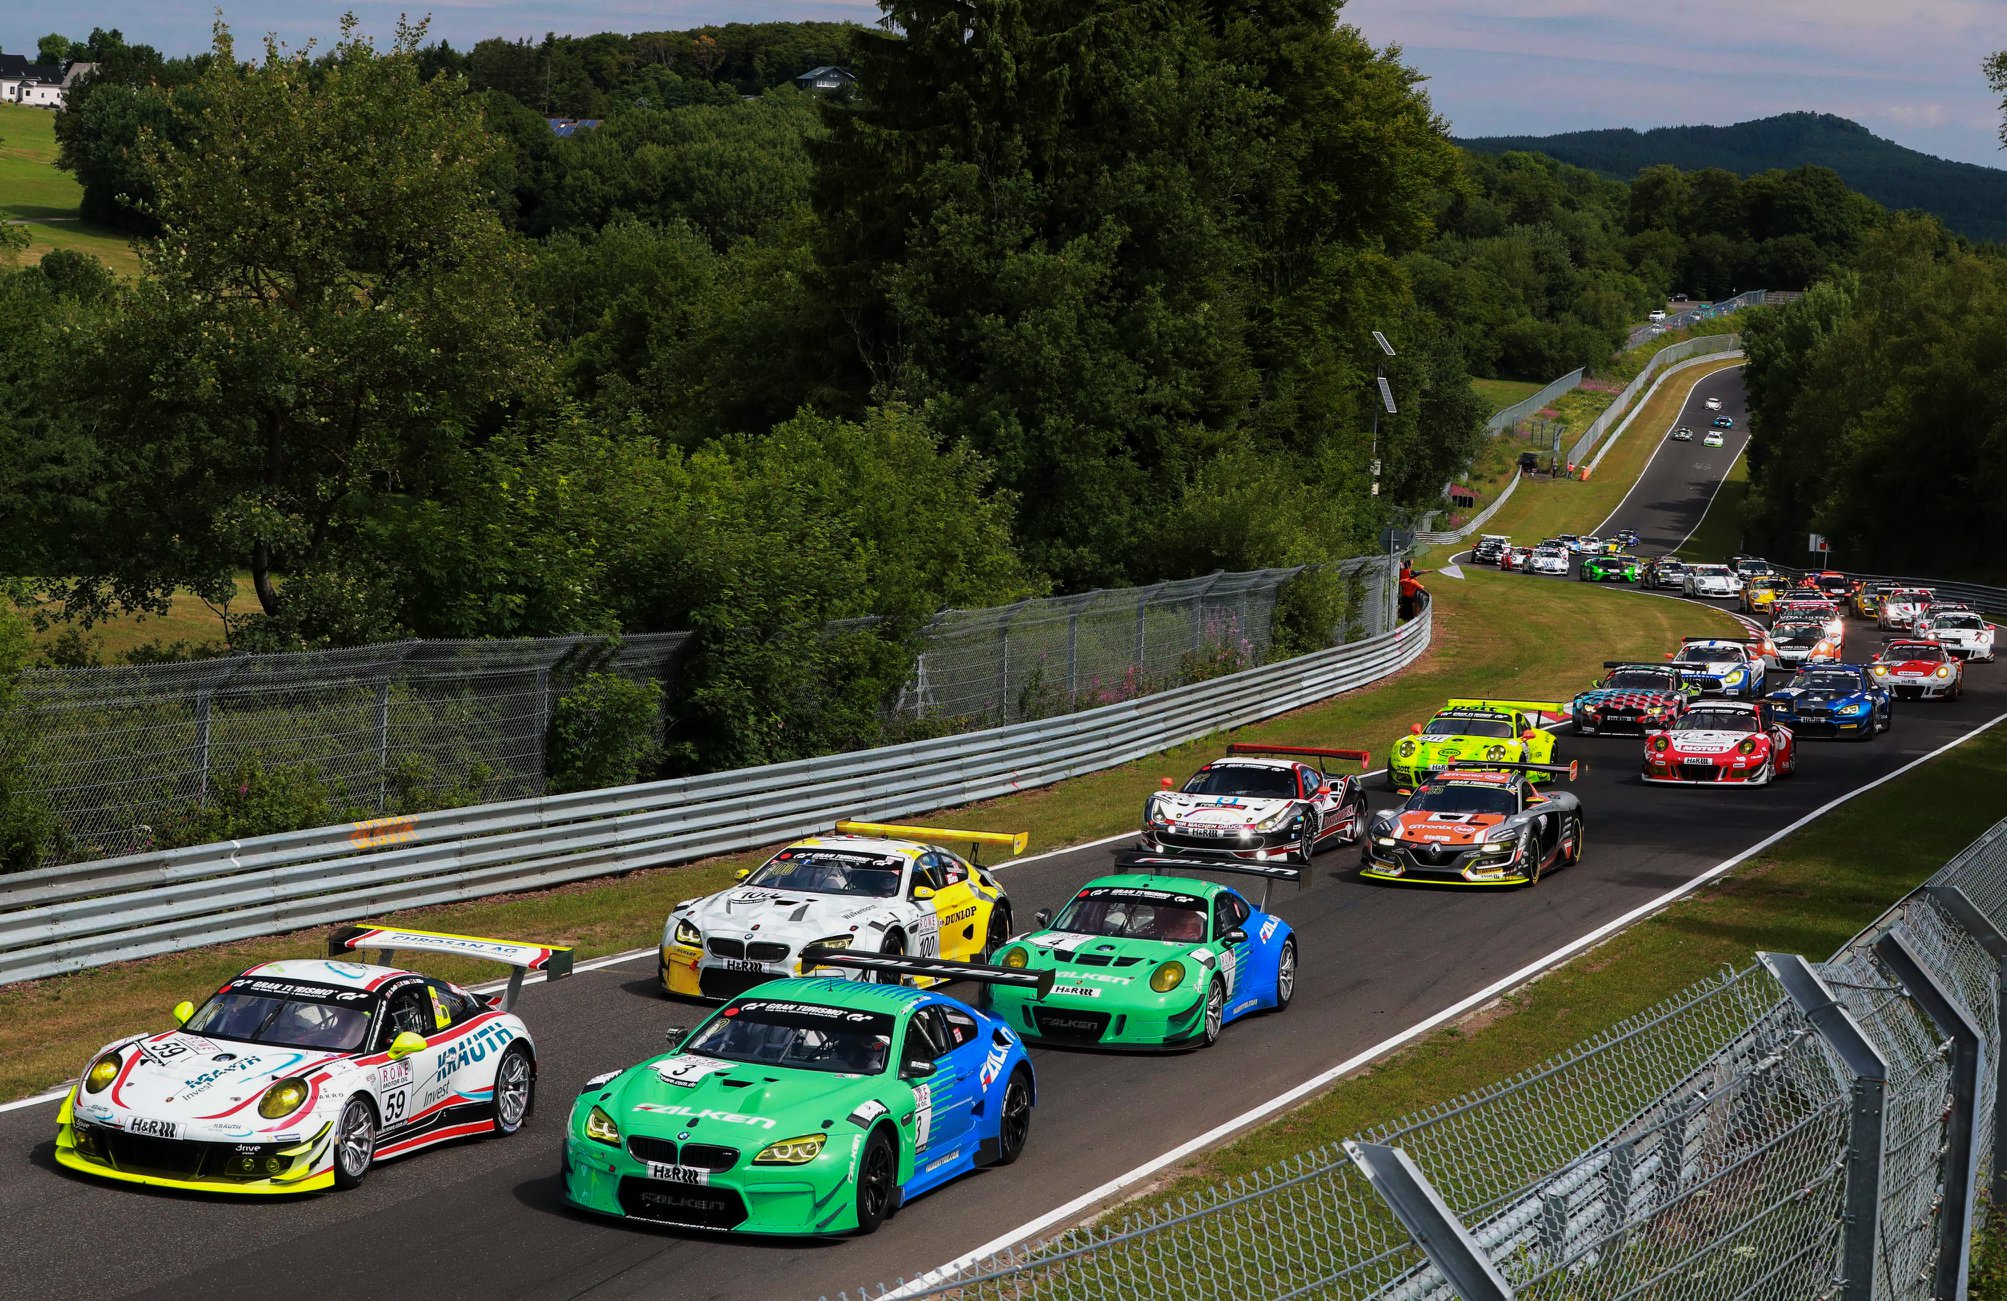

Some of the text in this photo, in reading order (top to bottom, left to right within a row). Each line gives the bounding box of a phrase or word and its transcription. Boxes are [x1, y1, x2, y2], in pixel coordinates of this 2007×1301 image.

[1187, 822, 1217, 830] MACHEN
[1217, 823, 1244, 831] DRUCK
[1192, 828, 1210, 838] H&R
[813, 852, 836, 860] GRAN
[835, 853, 870, 863] TURISMO
[945, 905, 977, 927] DUNLOP
[920, 935, 935, 959] 100
[726, 959, 748, 972] H&R
[252, 981, 283, 991] GRAN
[1055, 970, 1130, 986] ALKEN
[1055, 985, 1080, 995] H&R
[765, 1003, 844, 1016] GRAN TURISMO
[1042, 1017, 1099, 1031] FALKEN
[150, 1042, 188, 1059] 59
[436, 1022, 514, 1083] KRAUTH
[383, 1061, 409, 1083] ROWE
[382, 1078, 400, 1089] MOTOR
[400, 1076, 409, 1084] OIL
[181, 1081, 214, 1102] Invest
[422, 1079, 450, 1108] Invest
[384, 1090, 406, 1123] 59
[631, 1102, 778, 1130] FALKEN
[131, 1117, 158, 1135] H&R
[235, 1143, 261, 1152] drive
[848, 1133, 863, 1184] FALKEN
[653, 1164, 682, 1181] H&R
[639, 1191, 726, 1211] FALKEN
